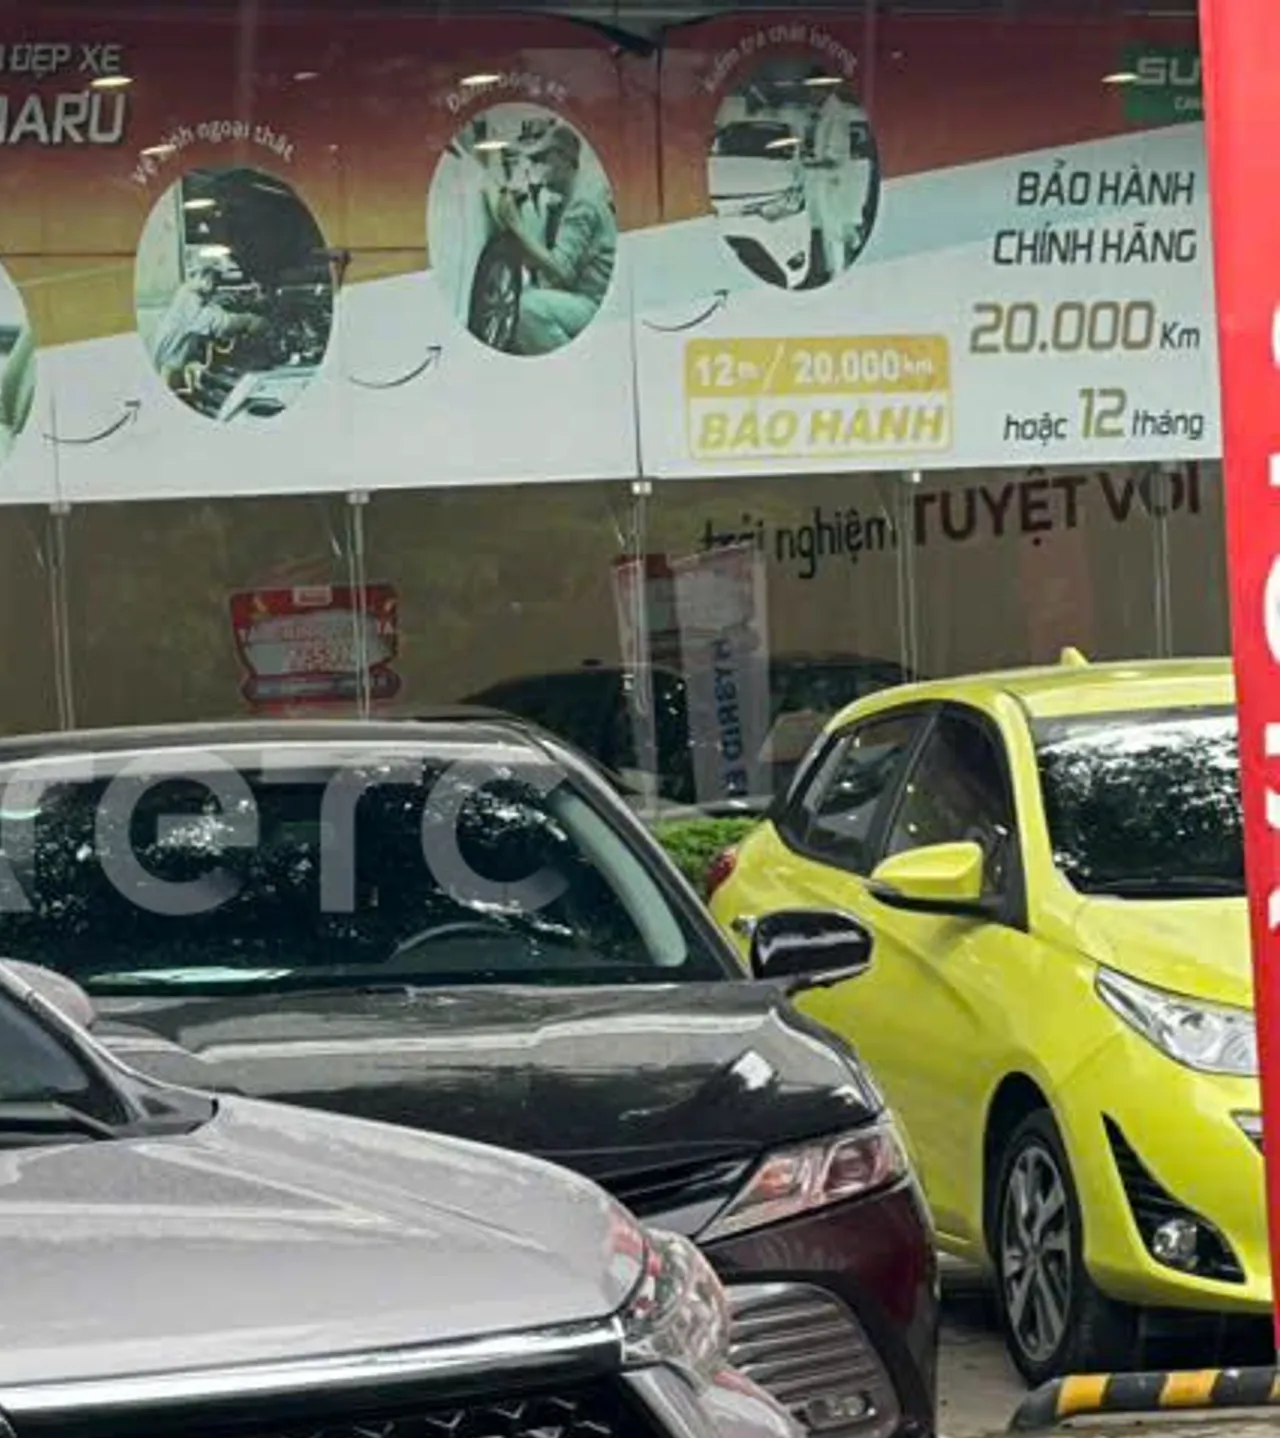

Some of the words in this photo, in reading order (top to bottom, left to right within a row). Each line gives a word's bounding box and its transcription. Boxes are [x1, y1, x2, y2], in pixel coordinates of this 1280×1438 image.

[79, 43, 125, 74] XE
[1136, 56, 1200, 86] SU
[1017, 158, 1091, 206] BẢO
[1098, 164, 1196, 206] HÀNH
[993, 221, 1095, 265] CHÍNH
[1100, 222, 1197, 264] HÃNG
[970, 301, 1156, 354] 20.000
[1003, 412, 1068, 446] hoặc
[1078, 387, 1127, 439] 12
[1132, 409, 1204, 440] tháng
[776, 507, 897, 579] nghiệm
[913, 467, 1091, 547] TUYỆT
